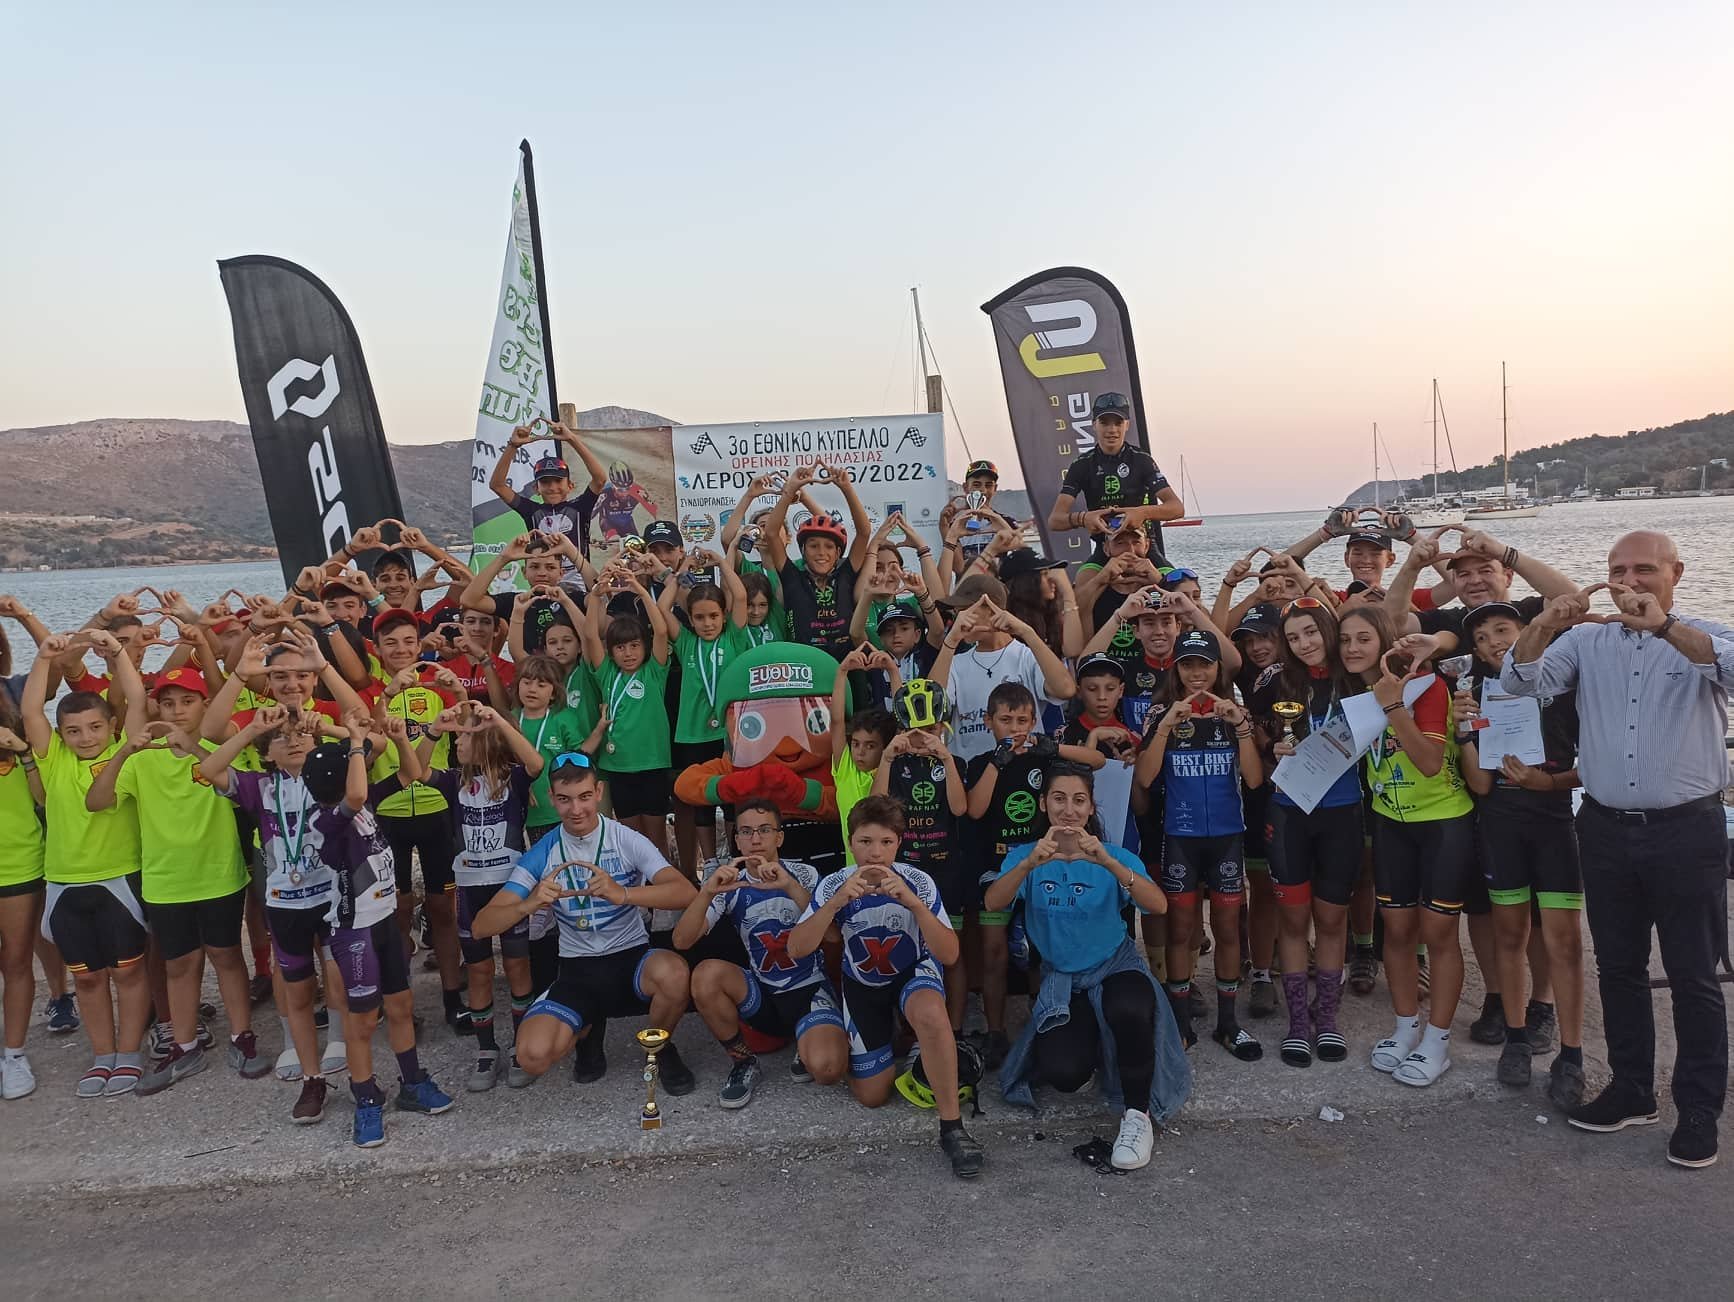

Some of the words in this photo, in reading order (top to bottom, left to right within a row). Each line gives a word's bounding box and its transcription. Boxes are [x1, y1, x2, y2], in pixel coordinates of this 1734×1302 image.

[754, 431, 812, 454] ΕΘΝΙΚΟ
[817, 427, 889, 451] ΚΥΠΕΛΛΟ
[732, 455, 790, 469] ΟΡΕΙΝΗΣ
[692, 471, 756, 490] ΛΕΡΟΣ
[1172, 754, 1200, 766] BEST
[909, 817, 934, 828] piro
[1002, 827, 1030, 837] RAFN
[854, 934, 903, 976] X
